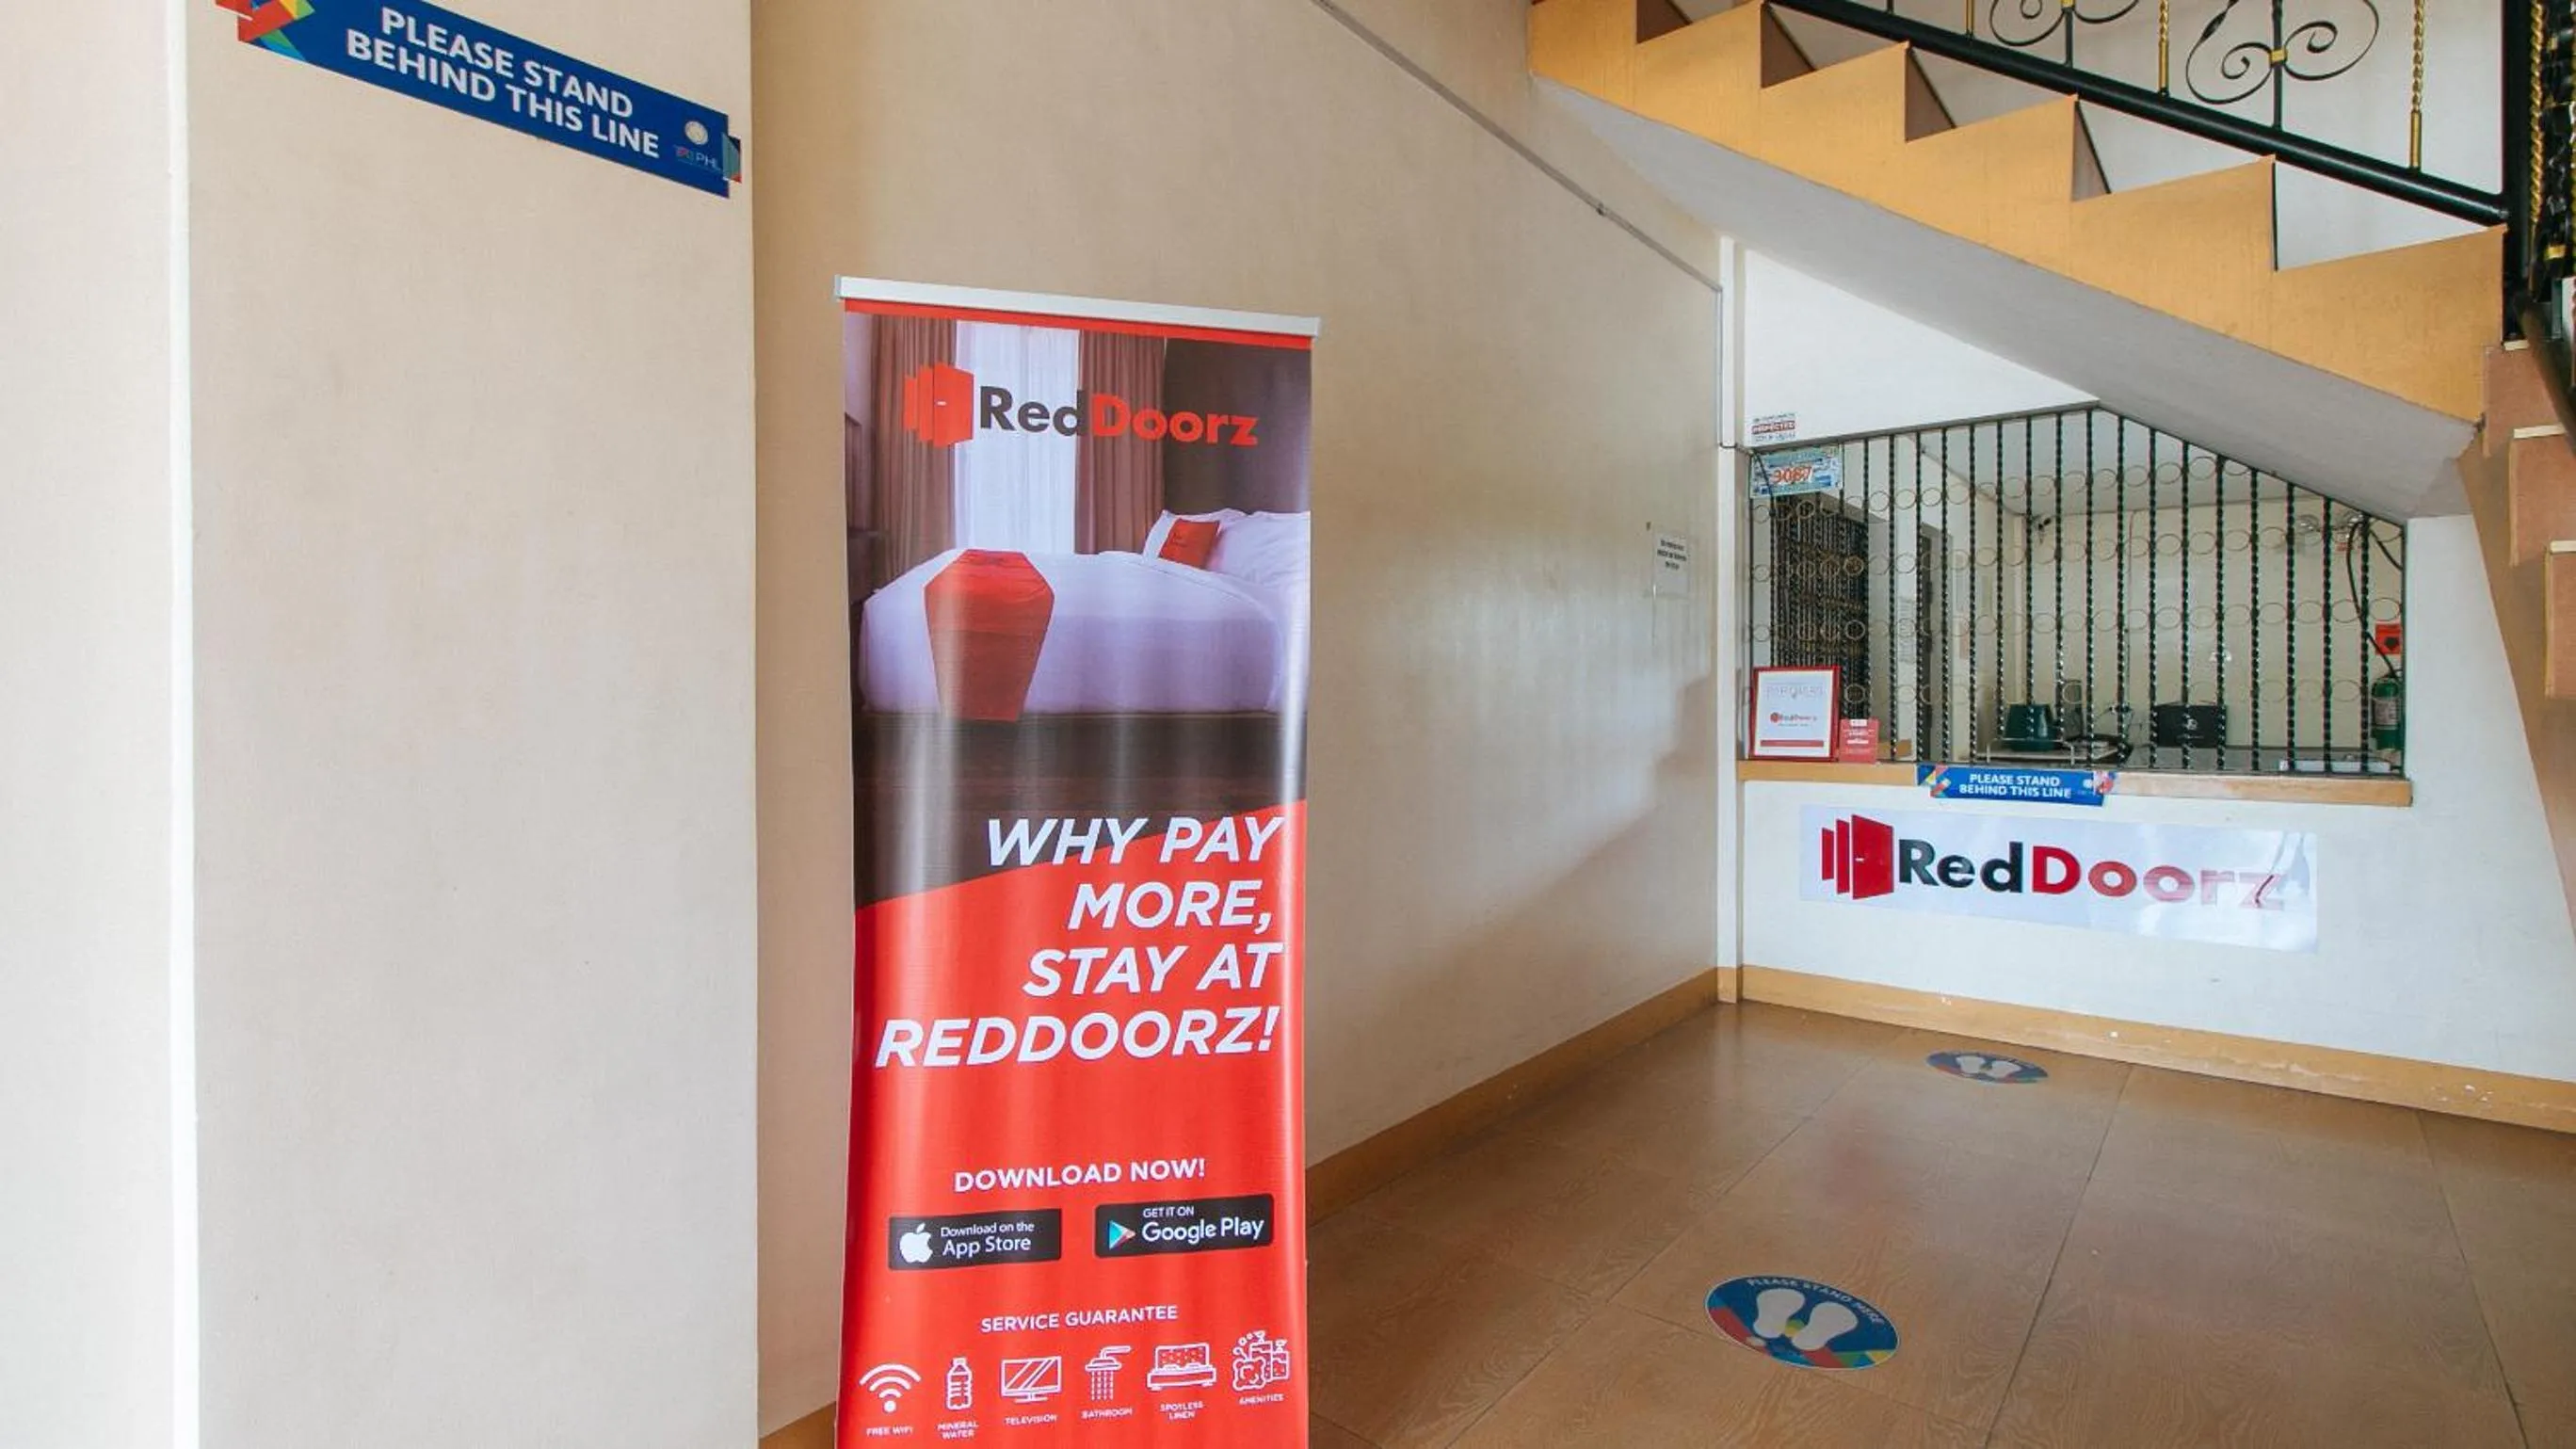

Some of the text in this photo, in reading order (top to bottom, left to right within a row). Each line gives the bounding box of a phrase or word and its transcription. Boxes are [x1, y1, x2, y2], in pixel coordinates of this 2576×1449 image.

[380, 8, 633, 119] PLEASE STAND
[346, 29, 659, 159] BEHIND THIS LINE
[979, 385, 1258, 446] RedDoorz
[1970, 773, 2060, 787] PLEASE STAND
[1959, 783, 2006, 796] BEHIND
[2011, 785, 2039, 797] THIS
[2042, 787, 2070, 798] LINE
[988, 816, 1286, 866] WHY PAY
[1898, 838, 2290, 910] RedDoorz
[1067, 879, 1273, 934] MORE,
[1022, 942, 1285, 997] STAY AT
[875, 1006, 1281, 1068] REDDOORZ!
[954, 1158, 1206, 1193] DOWNLOAD NOW!
[1143, 1206, 1195, 1218] GET IT ON
[941, 1221, 1035, 1237] Download on the
[1142, 1216, 1264, 1245] Google Play
[942, 1236, 1031, 1259] App Store
[981, 1305, 1179, 1333] SERVICE GUARANTEE
[1160, 1401, 1203, 1412] SPOTLESS
[1239, 1393, 1285, 1406] AMENITIES
[1005, 1414, 1057, 1426] TELEVISION
[1081, 1408, 1133, 1420] BATHROOM
[1168, 1411, 1195, 1421] LINEN
[865, 1426, 889, 1437] FREE
[938, 1422, 978, 1431] MINERAL
[942, 1430, 975, 1441] WATER
